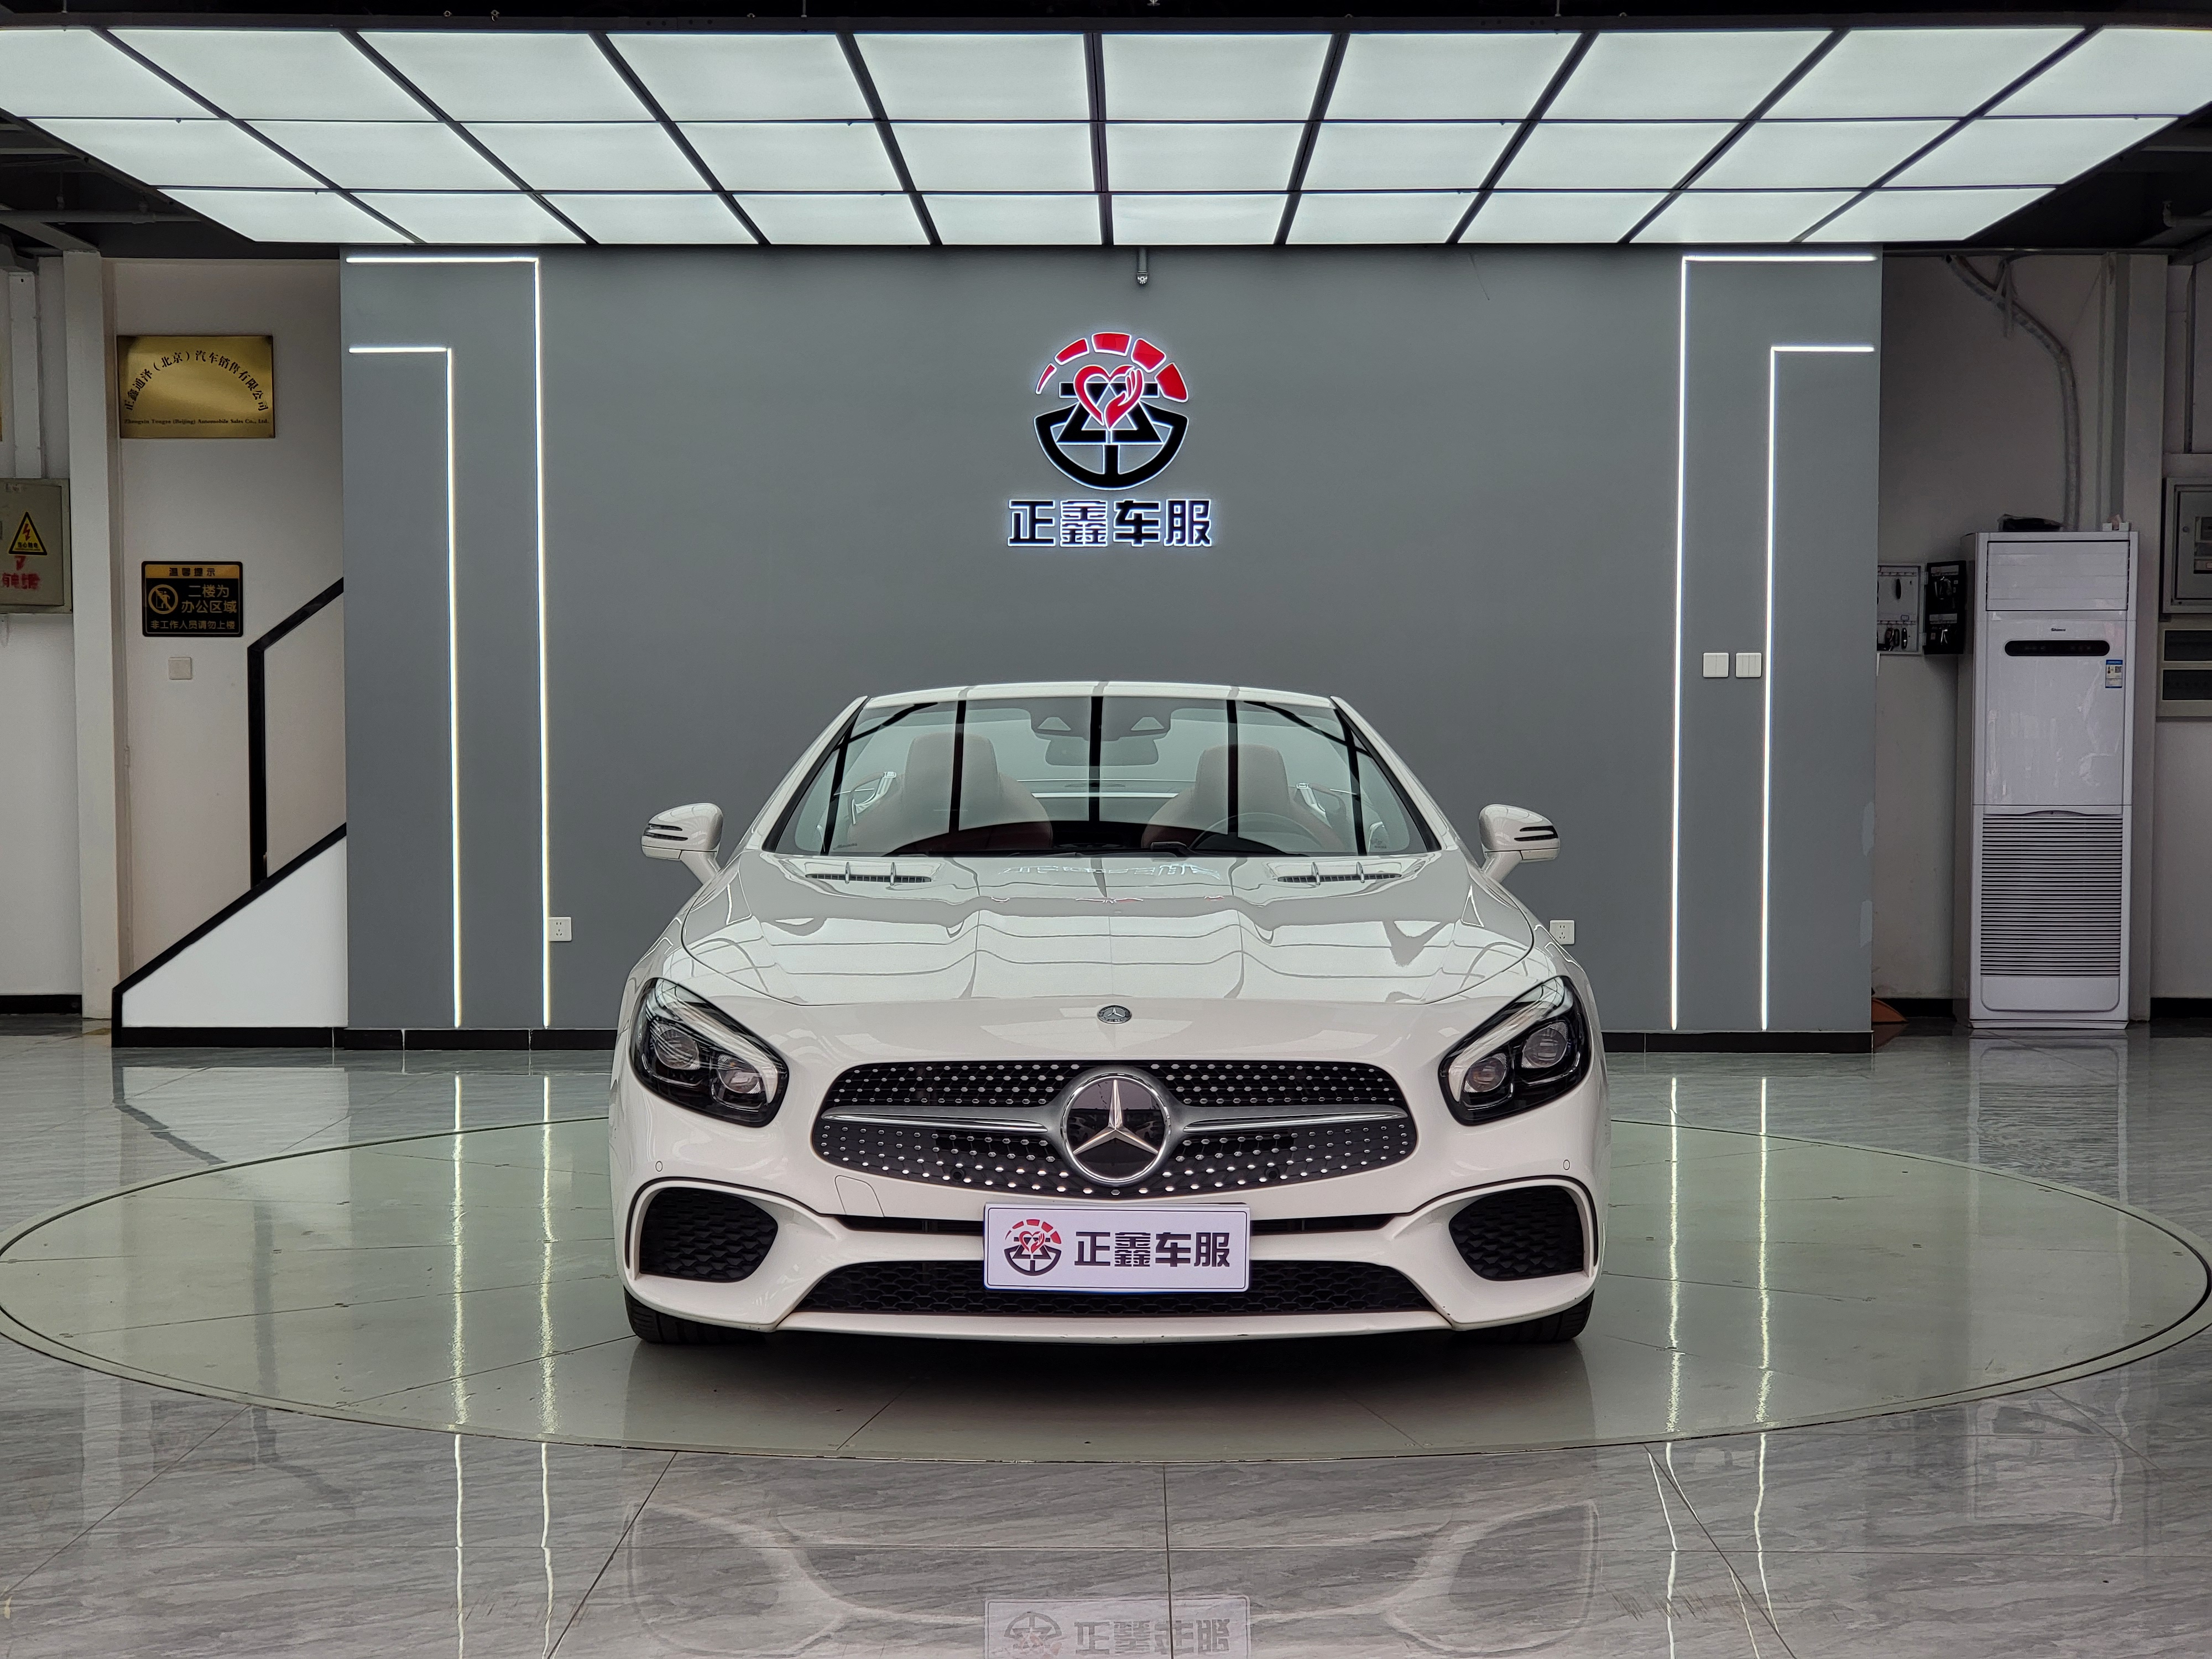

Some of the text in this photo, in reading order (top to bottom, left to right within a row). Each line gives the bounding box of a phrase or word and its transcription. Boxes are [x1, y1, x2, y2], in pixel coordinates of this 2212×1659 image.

[1008, 499, 1212, 547] 正鑫车服
[188, 583, 229, 598] 二楼为
[181, 600, 237, 614] 办公区域
[150, 620, 236, 630] 非工作人员请勿上楼
[1074, 1231, 1230, 1267] 正鑫车服
